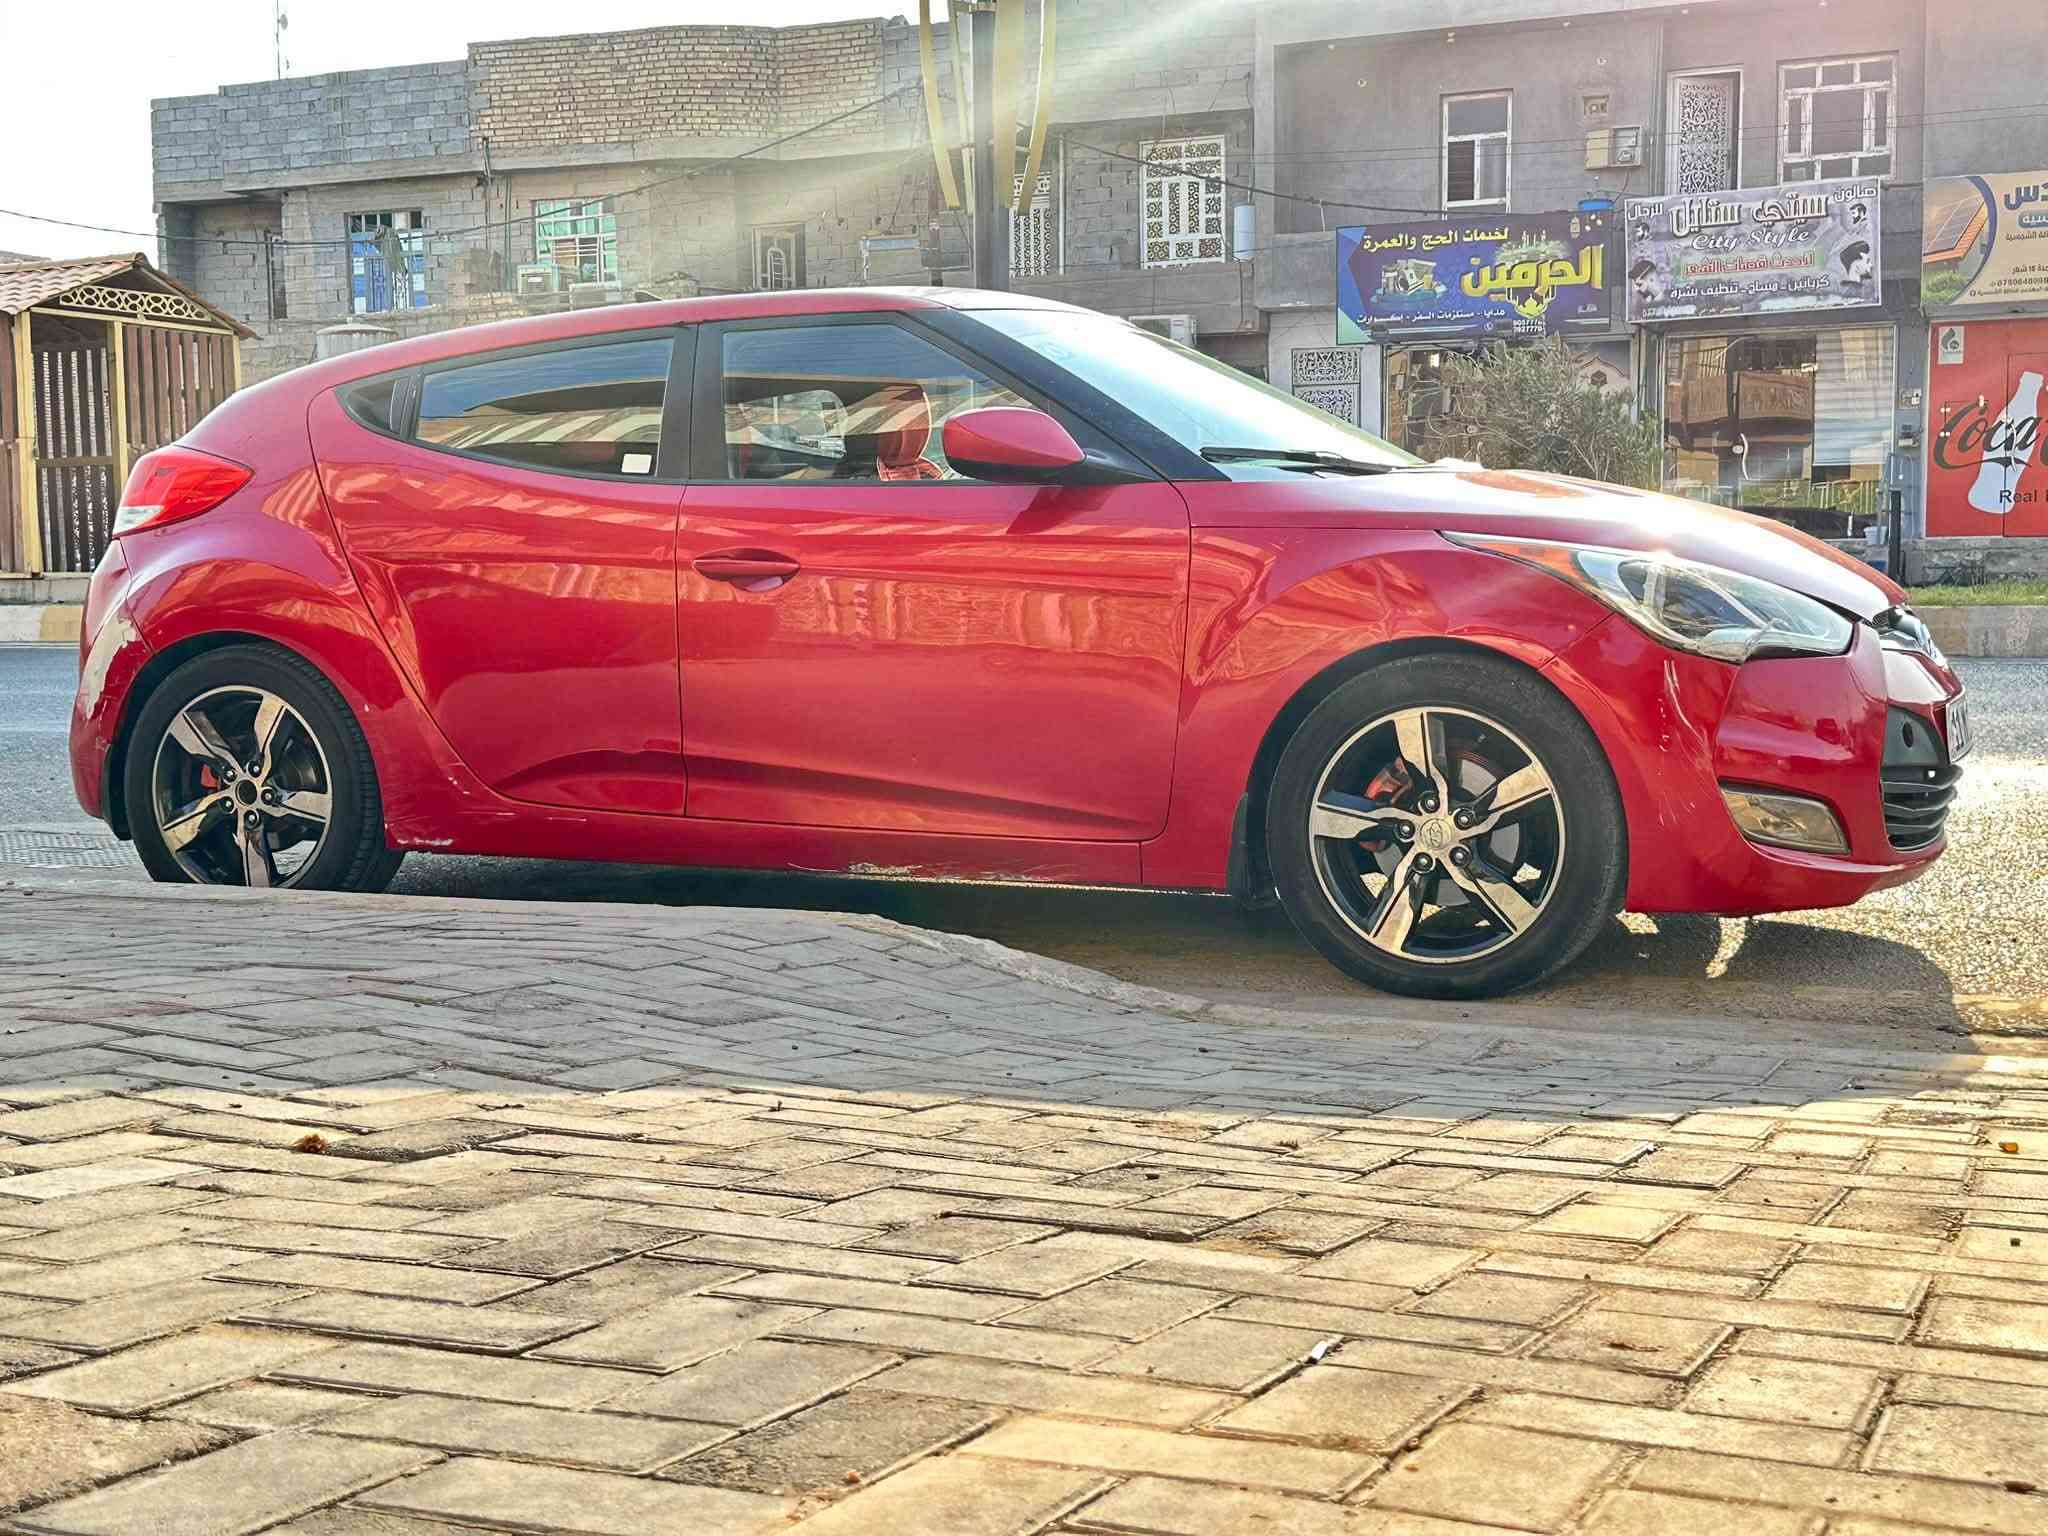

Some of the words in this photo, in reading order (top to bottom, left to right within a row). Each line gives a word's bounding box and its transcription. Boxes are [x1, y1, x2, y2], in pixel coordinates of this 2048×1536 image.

[1833, 185, 1877, 202] صالون
[1627, 203, 1663, 221] للرجال
[1669, 195, 1741, 239] ستايل
[1752, 191, 1829, 226] سيتي
[1363, 233, 1417, 252] والعمرة
[1422, 230, 1458, 250] الحج
[1692, 232, 1738, 251] City
[1749, 227, 1809, 248] Style
[1460, 243, 1604, 301] الحرمين
[1999, 488, 2037, 504] Real
